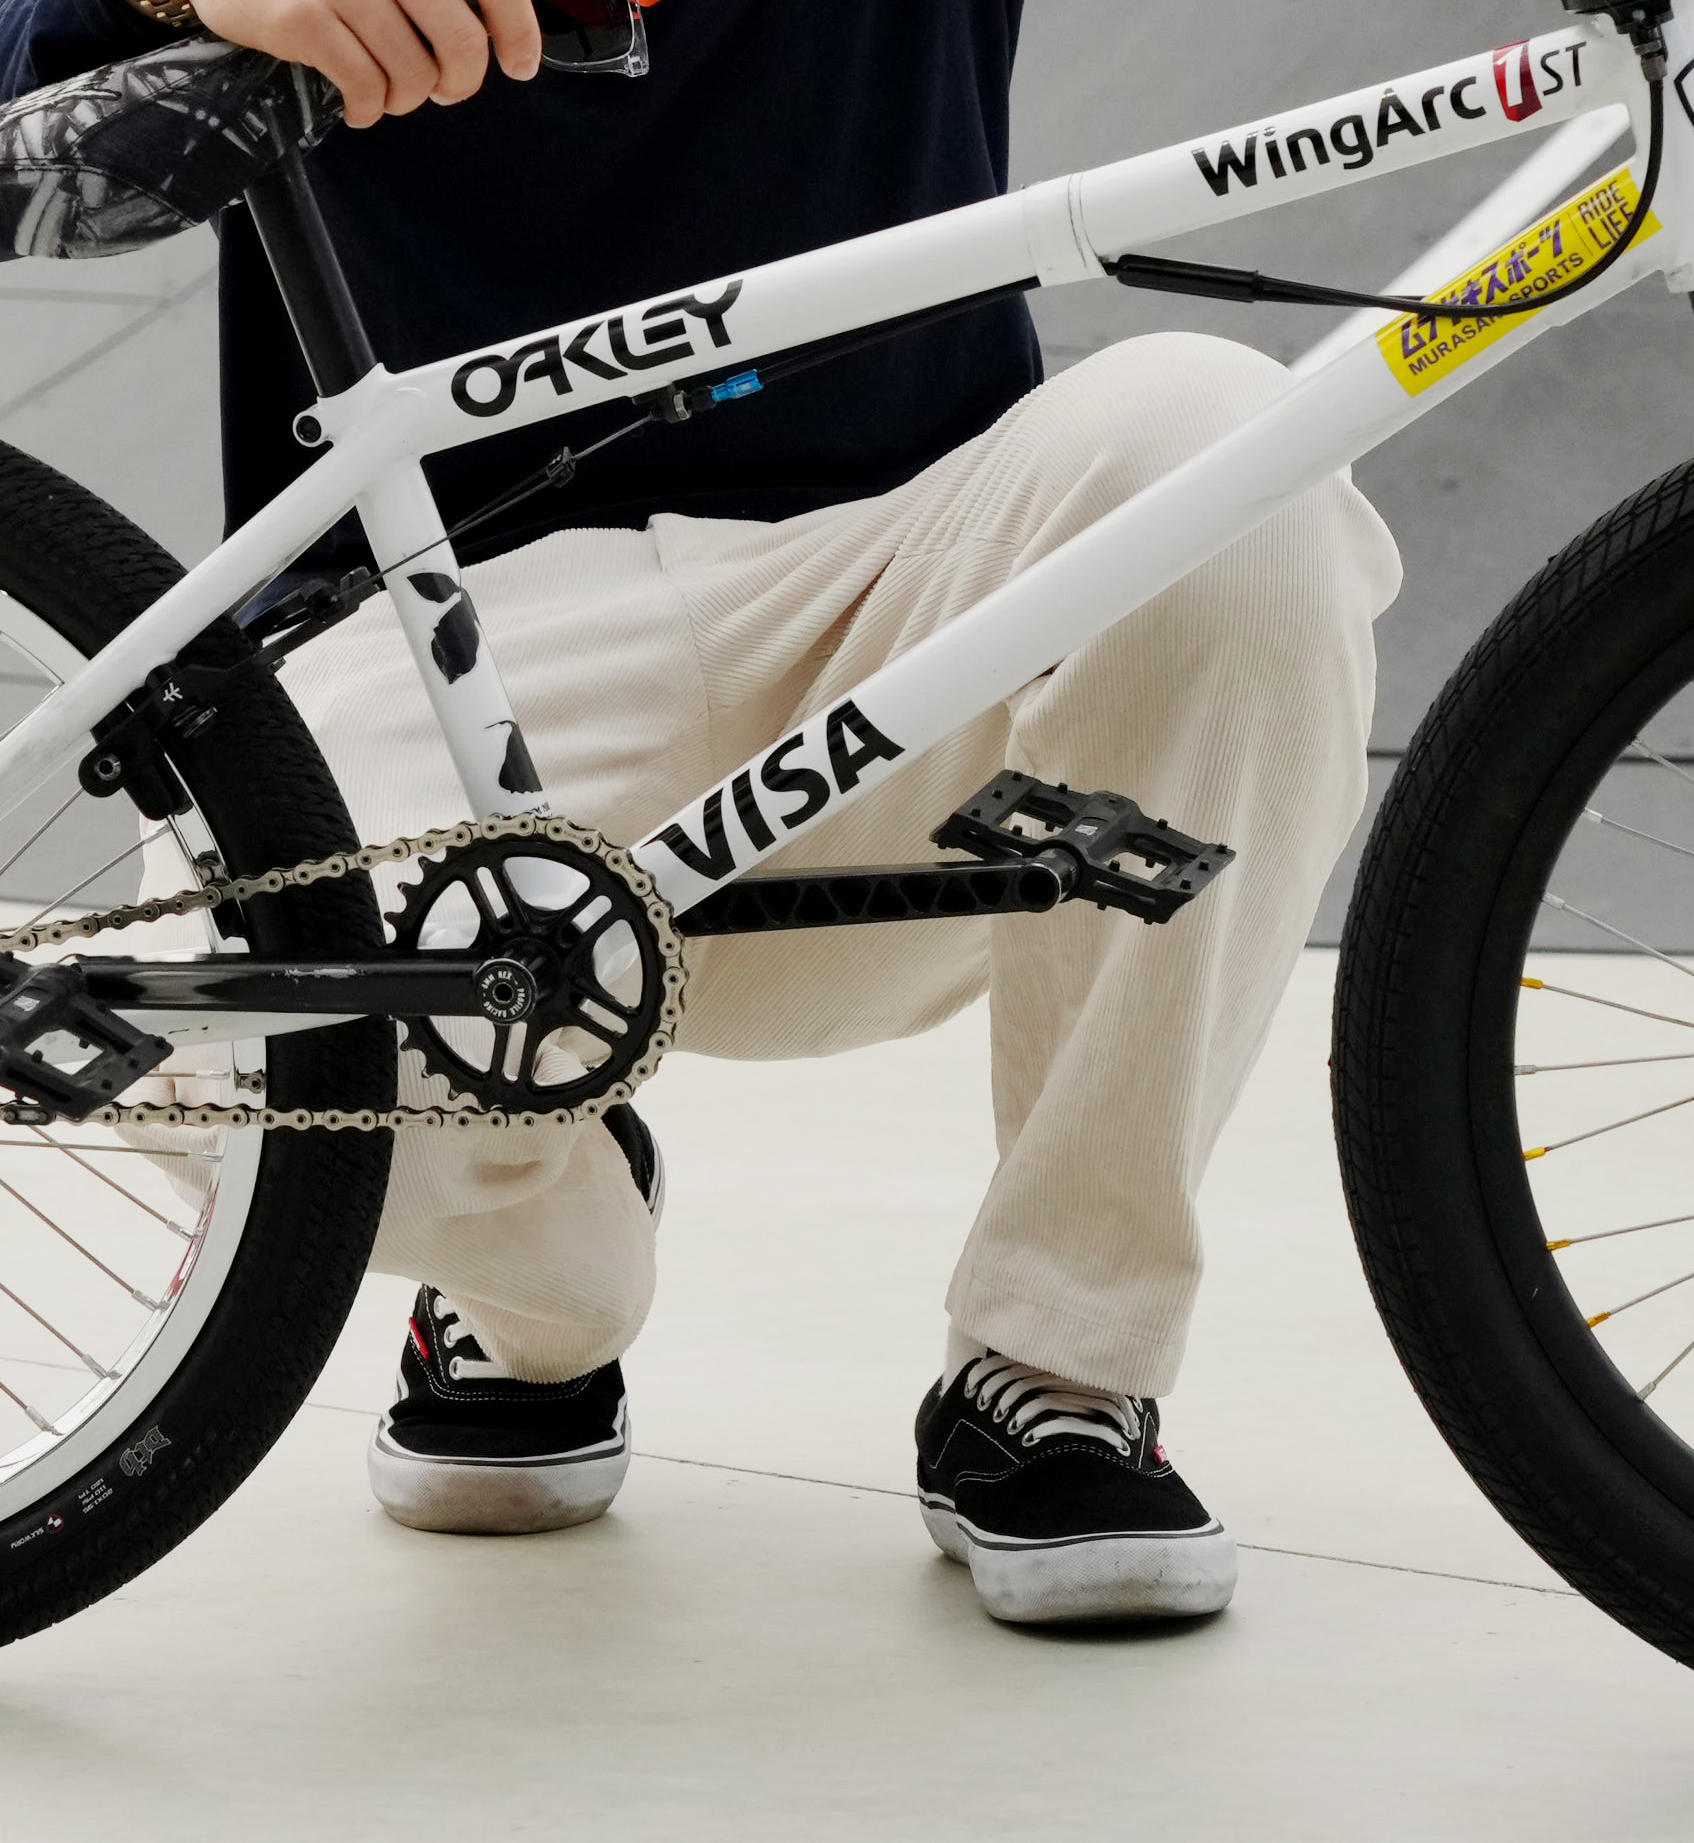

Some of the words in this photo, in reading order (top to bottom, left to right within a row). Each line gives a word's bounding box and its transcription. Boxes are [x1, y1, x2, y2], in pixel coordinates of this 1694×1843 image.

[1577, 179, 1626, 225] RIDE
[1509, 252, 1585, 304] SPORTS
[451, 278, 743, 418] OAKLEY
[656, 696, 906, 881] VISA
